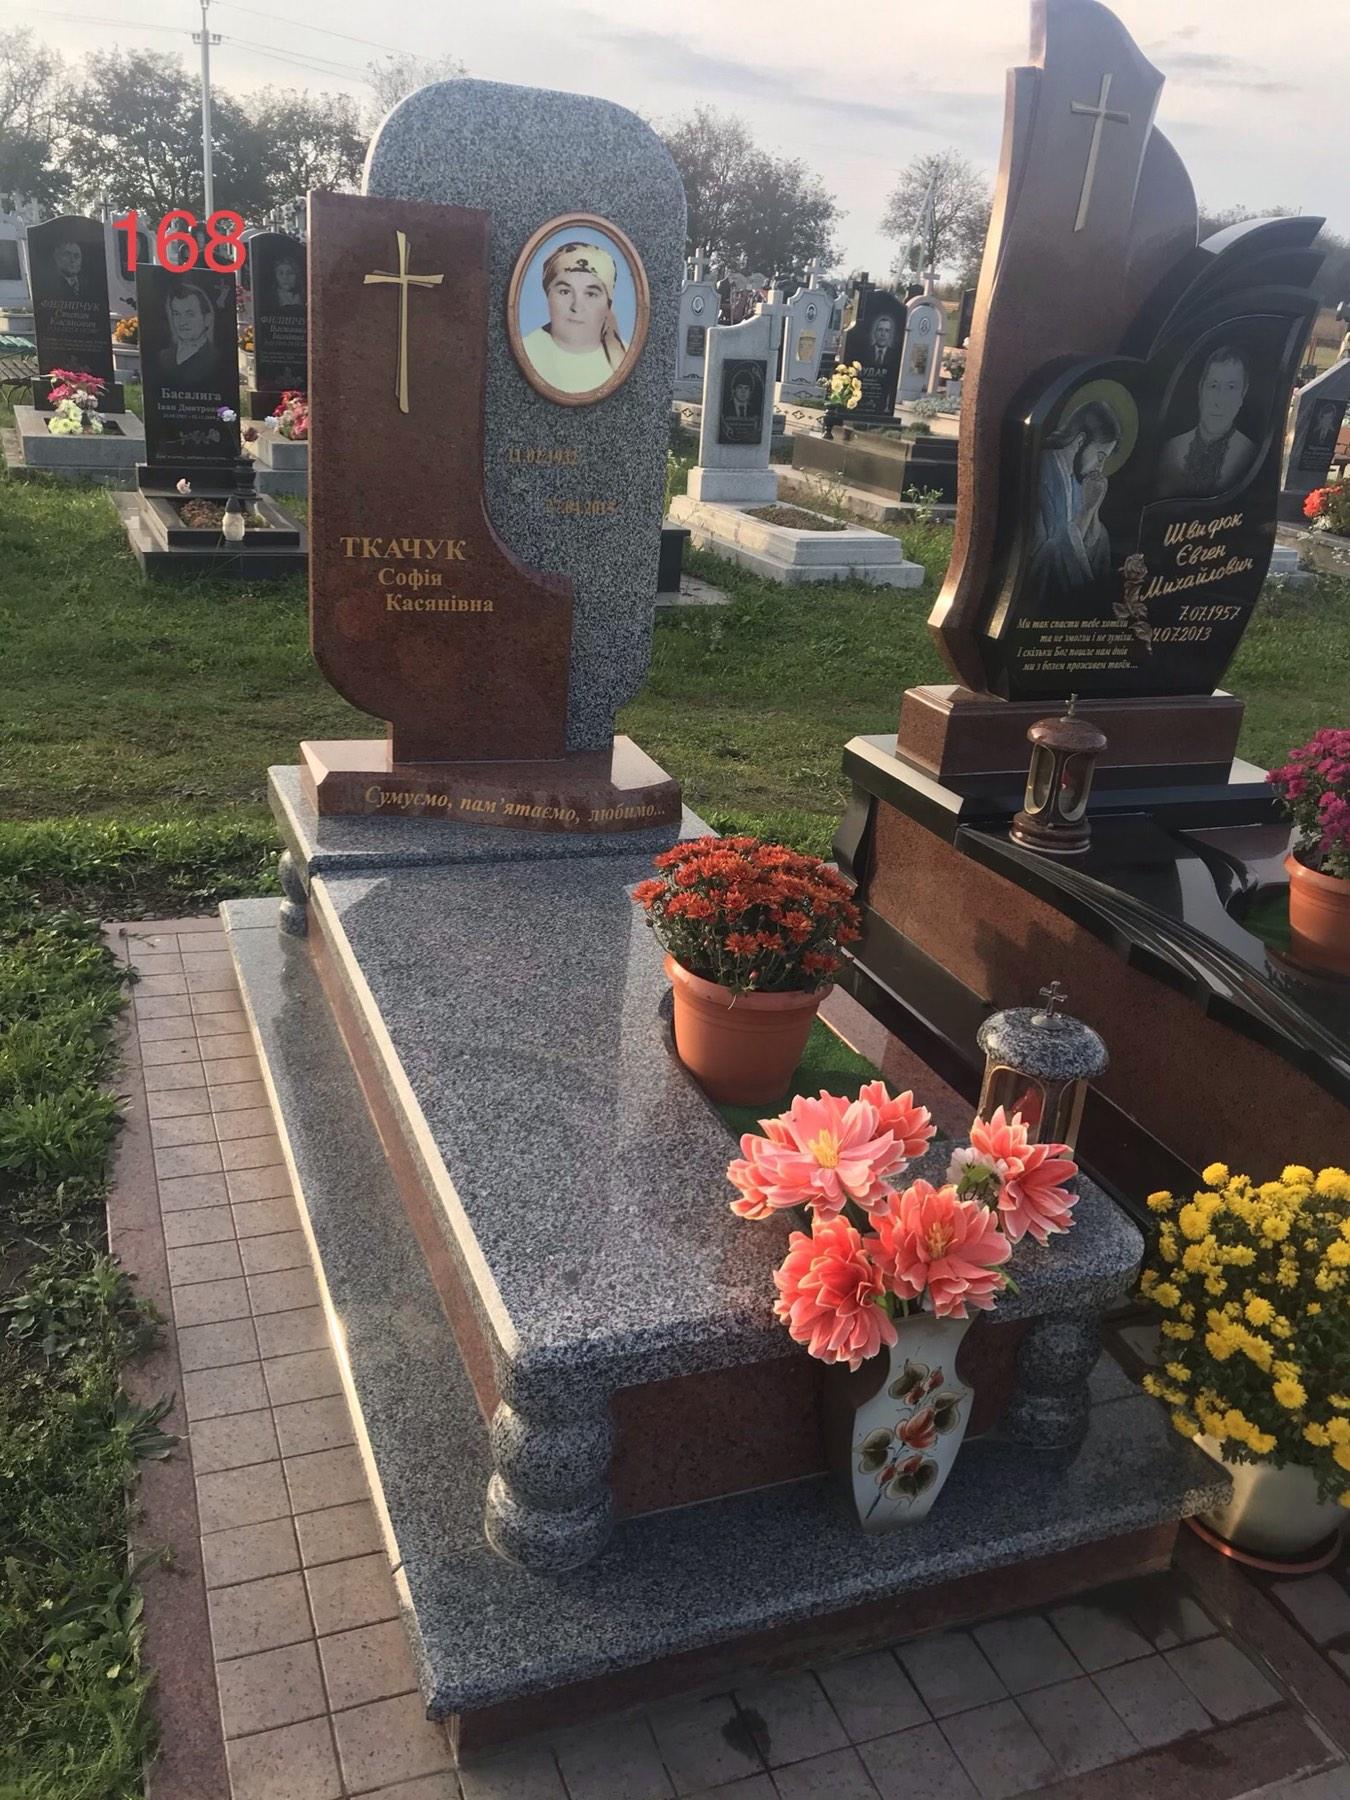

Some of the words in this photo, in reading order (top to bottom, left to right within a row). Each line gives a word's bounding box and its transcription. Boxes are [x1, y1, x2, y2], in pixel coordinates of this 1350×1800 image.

[1163, 513, 1243, 547] Швидюк
[340, 536, 467, 561] ТКАЧУК
[1176, 543, 1226, 566] Євген
[378, 567, 443, 591] Софія
[1139, 556, 1254, 601] Михайлович
[386, 592, 495, 612] Касянівна
[1178, 605, 1241, 621] 7.07.1957
[364, 785, 453, 810] Сумуємо,
[588, 802, 666, 823] любимо...
